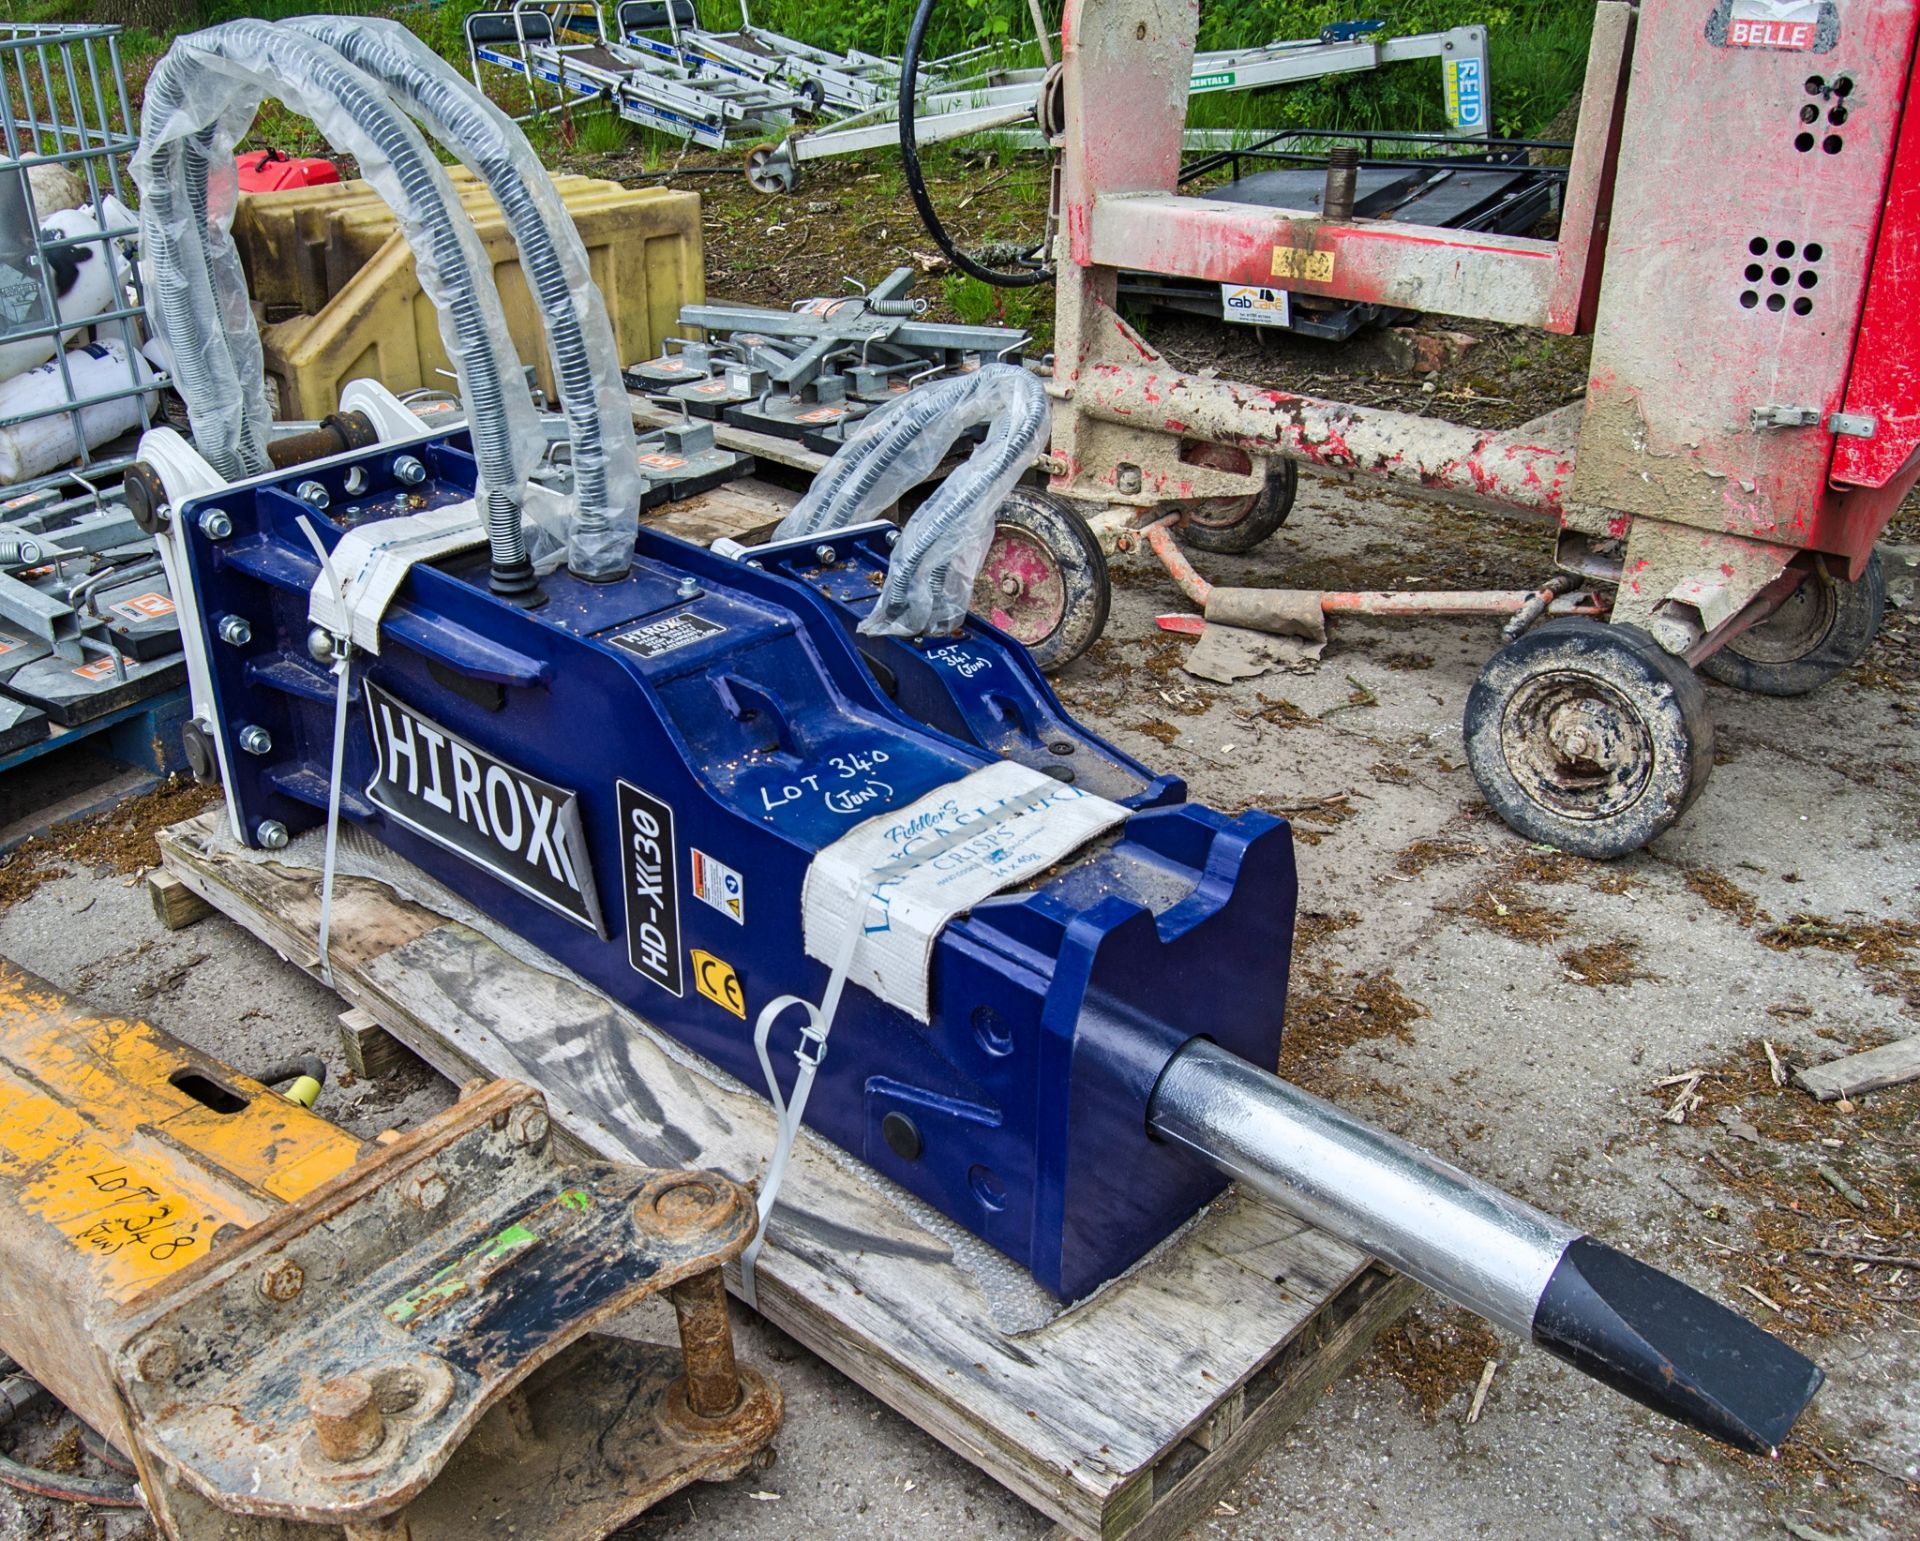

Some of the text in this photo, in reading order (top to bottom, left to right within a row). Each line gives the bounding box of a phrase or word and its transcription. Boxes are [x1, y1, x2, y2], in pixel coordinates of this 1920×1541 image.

[1732, 23, 1808, 46] BELLE
[1458, 61, 1480, 122] REID
[926, 644, 959, 660] LOT
[941, 651, 972, 667] 341
[957, 656, 993, 678] (JUN)
[760, 750, 890, 811] LOT 340
[824, 779, 894, 814] (JUN)
[933, 825, 1015, 872] CRISPS
[701, 960, 740, 1010] CE
[86, 1165, 161, 1203] LOT
